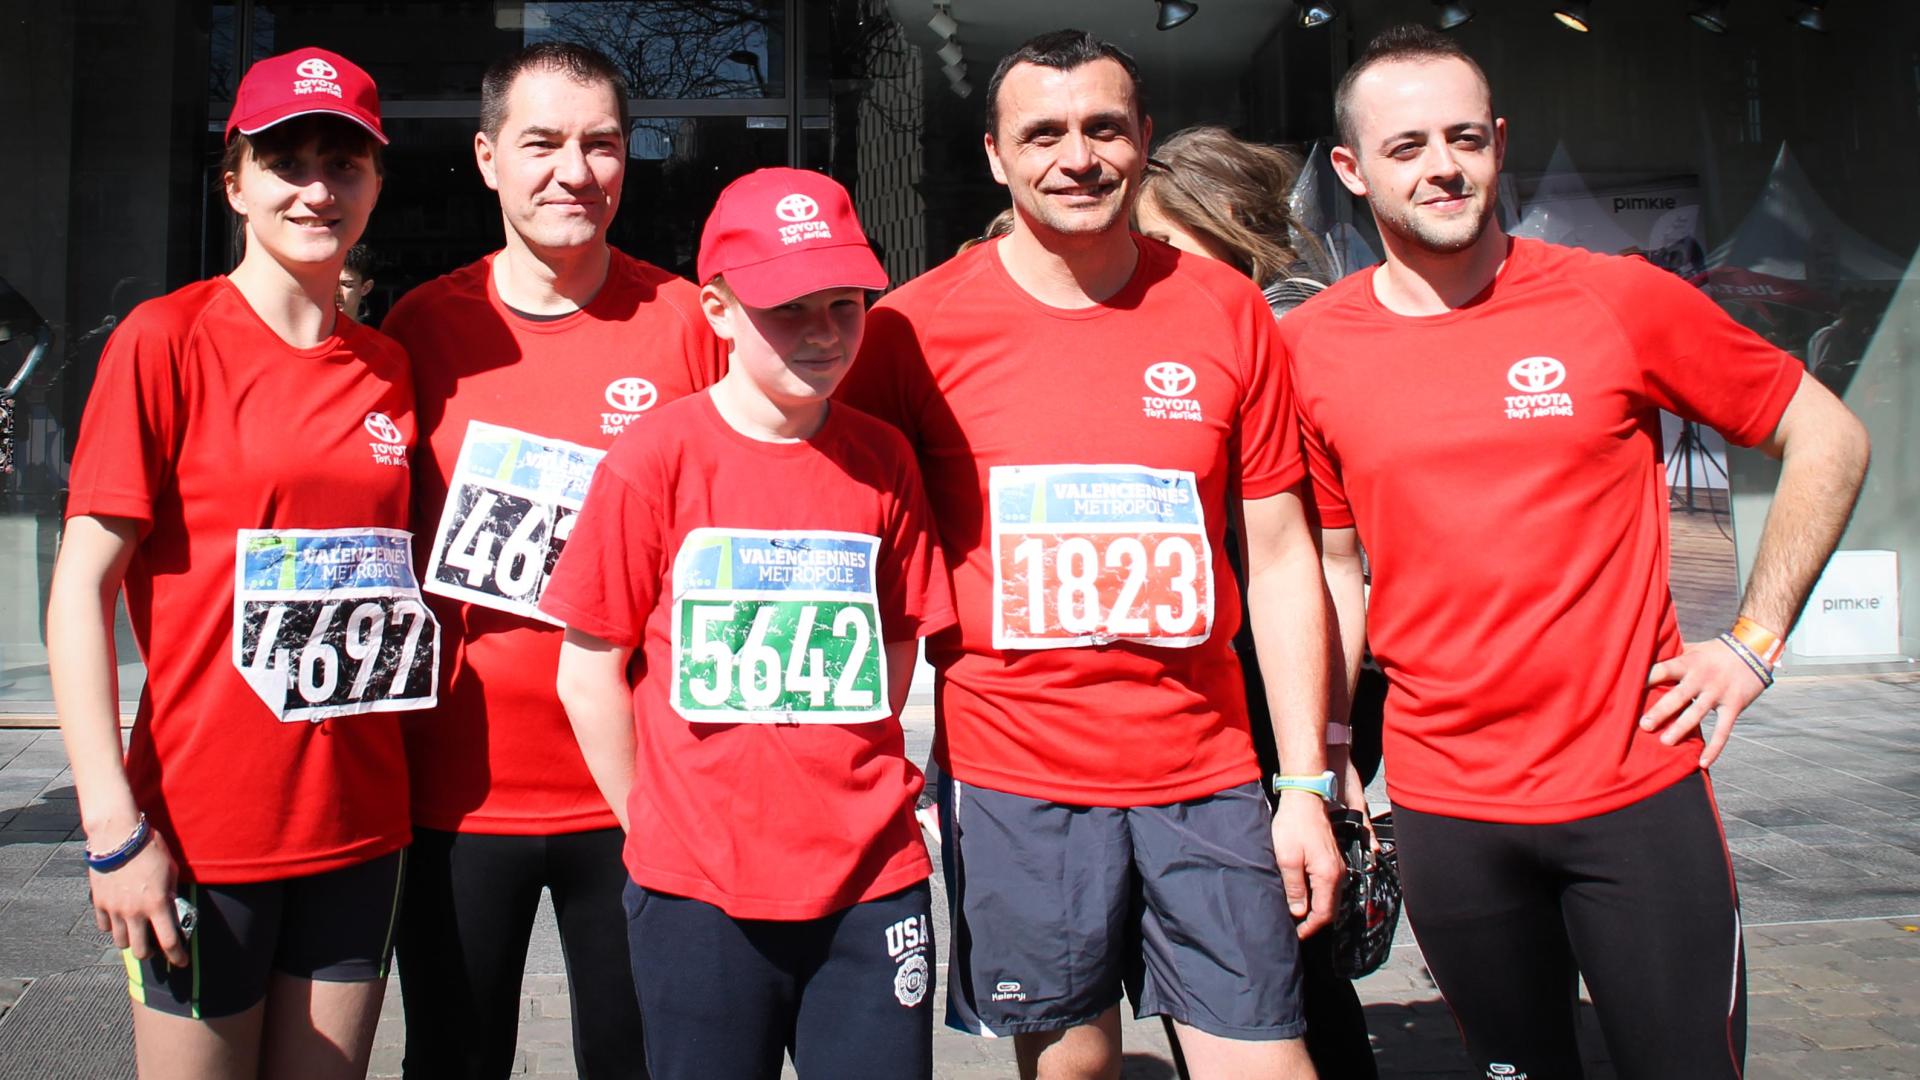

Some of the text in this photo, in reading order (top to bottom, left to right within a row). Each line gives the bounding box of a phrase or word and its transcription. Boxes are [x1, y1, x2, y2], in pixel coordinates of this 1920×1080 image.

[293, 79, 342, 92] TOYOTA
[1613, 195, 1676, 214] pimkie
[779, 221, 829, 236] TOYOTA
[1142, 396, 1201, 412] TOYOTA
[1504, 392, 1573, 410] TOYOTA
[1053, 482, 1190, 505] VALENCIENNES
[1074, 499, 1174, 518] METROPOLE
[304, 547, 406, 565] VALENCIENNES
[738, 547, 866, 569] VALENCIENNES
[322, 563, 401, 582] METROPOE
[758, 565, 855, 584] METROPOLE
[1014, 536, 1198, 634] 1823
[1823, 597, 1881, 614] pimkie
[251, 600, 426, 704] 4697
[689, 604, 874, 708] 5642
[885, 914, 929, 957] USA
